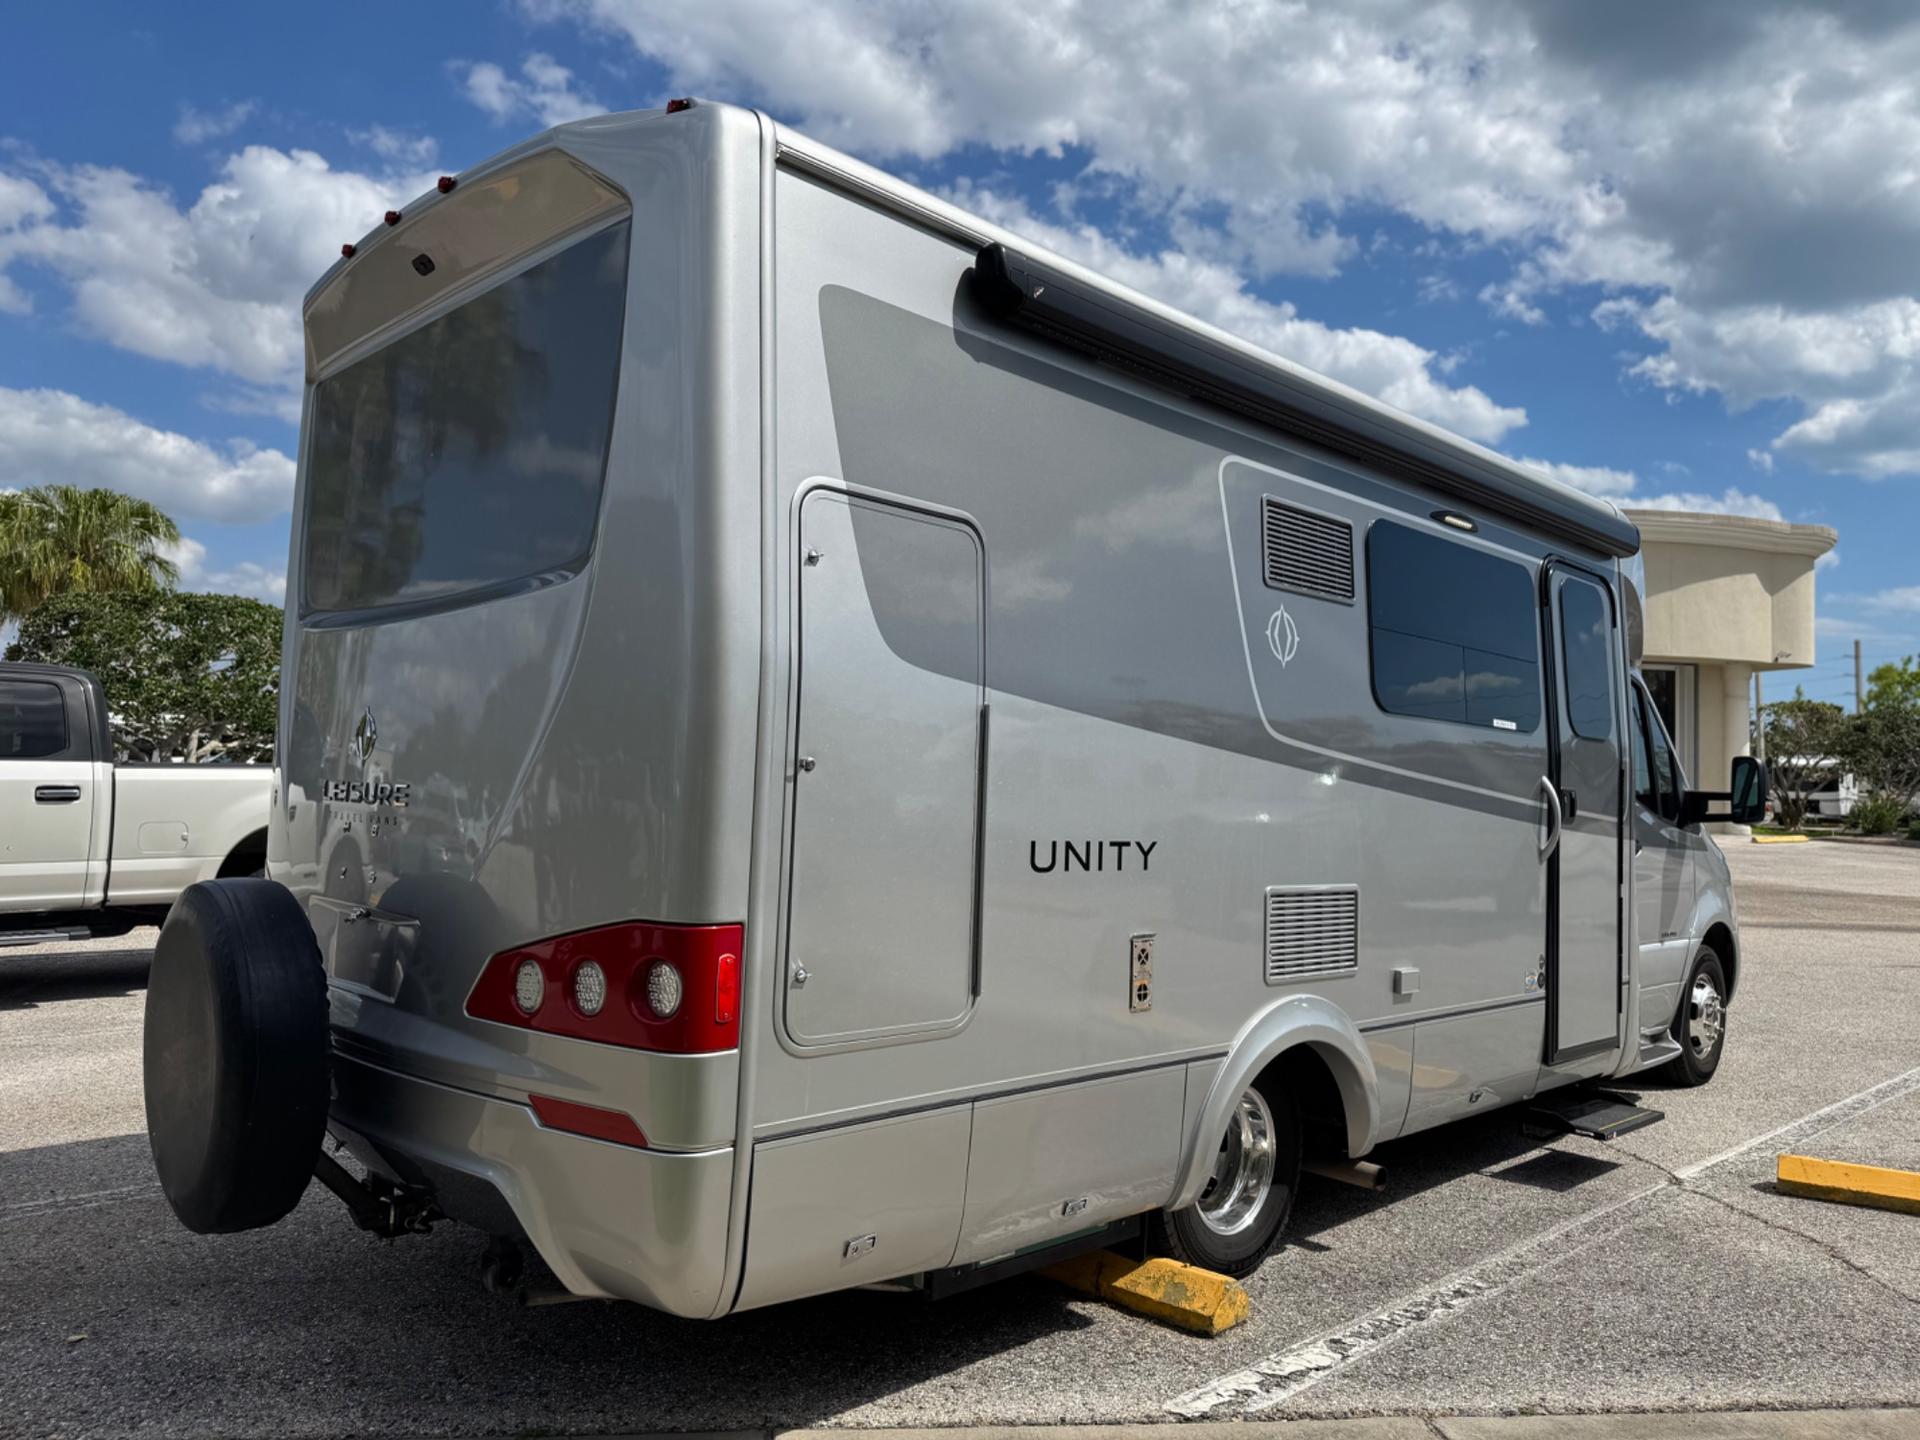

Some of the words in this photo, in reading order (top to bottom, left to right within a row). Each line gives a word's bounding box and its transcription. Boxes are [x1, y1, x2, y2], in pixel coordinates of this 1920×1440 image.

[324, 779, 410, 807] LEISURE
[328, 810, 363, 823] RAVEL
[1030, 840, 1158, 873] UNITY
